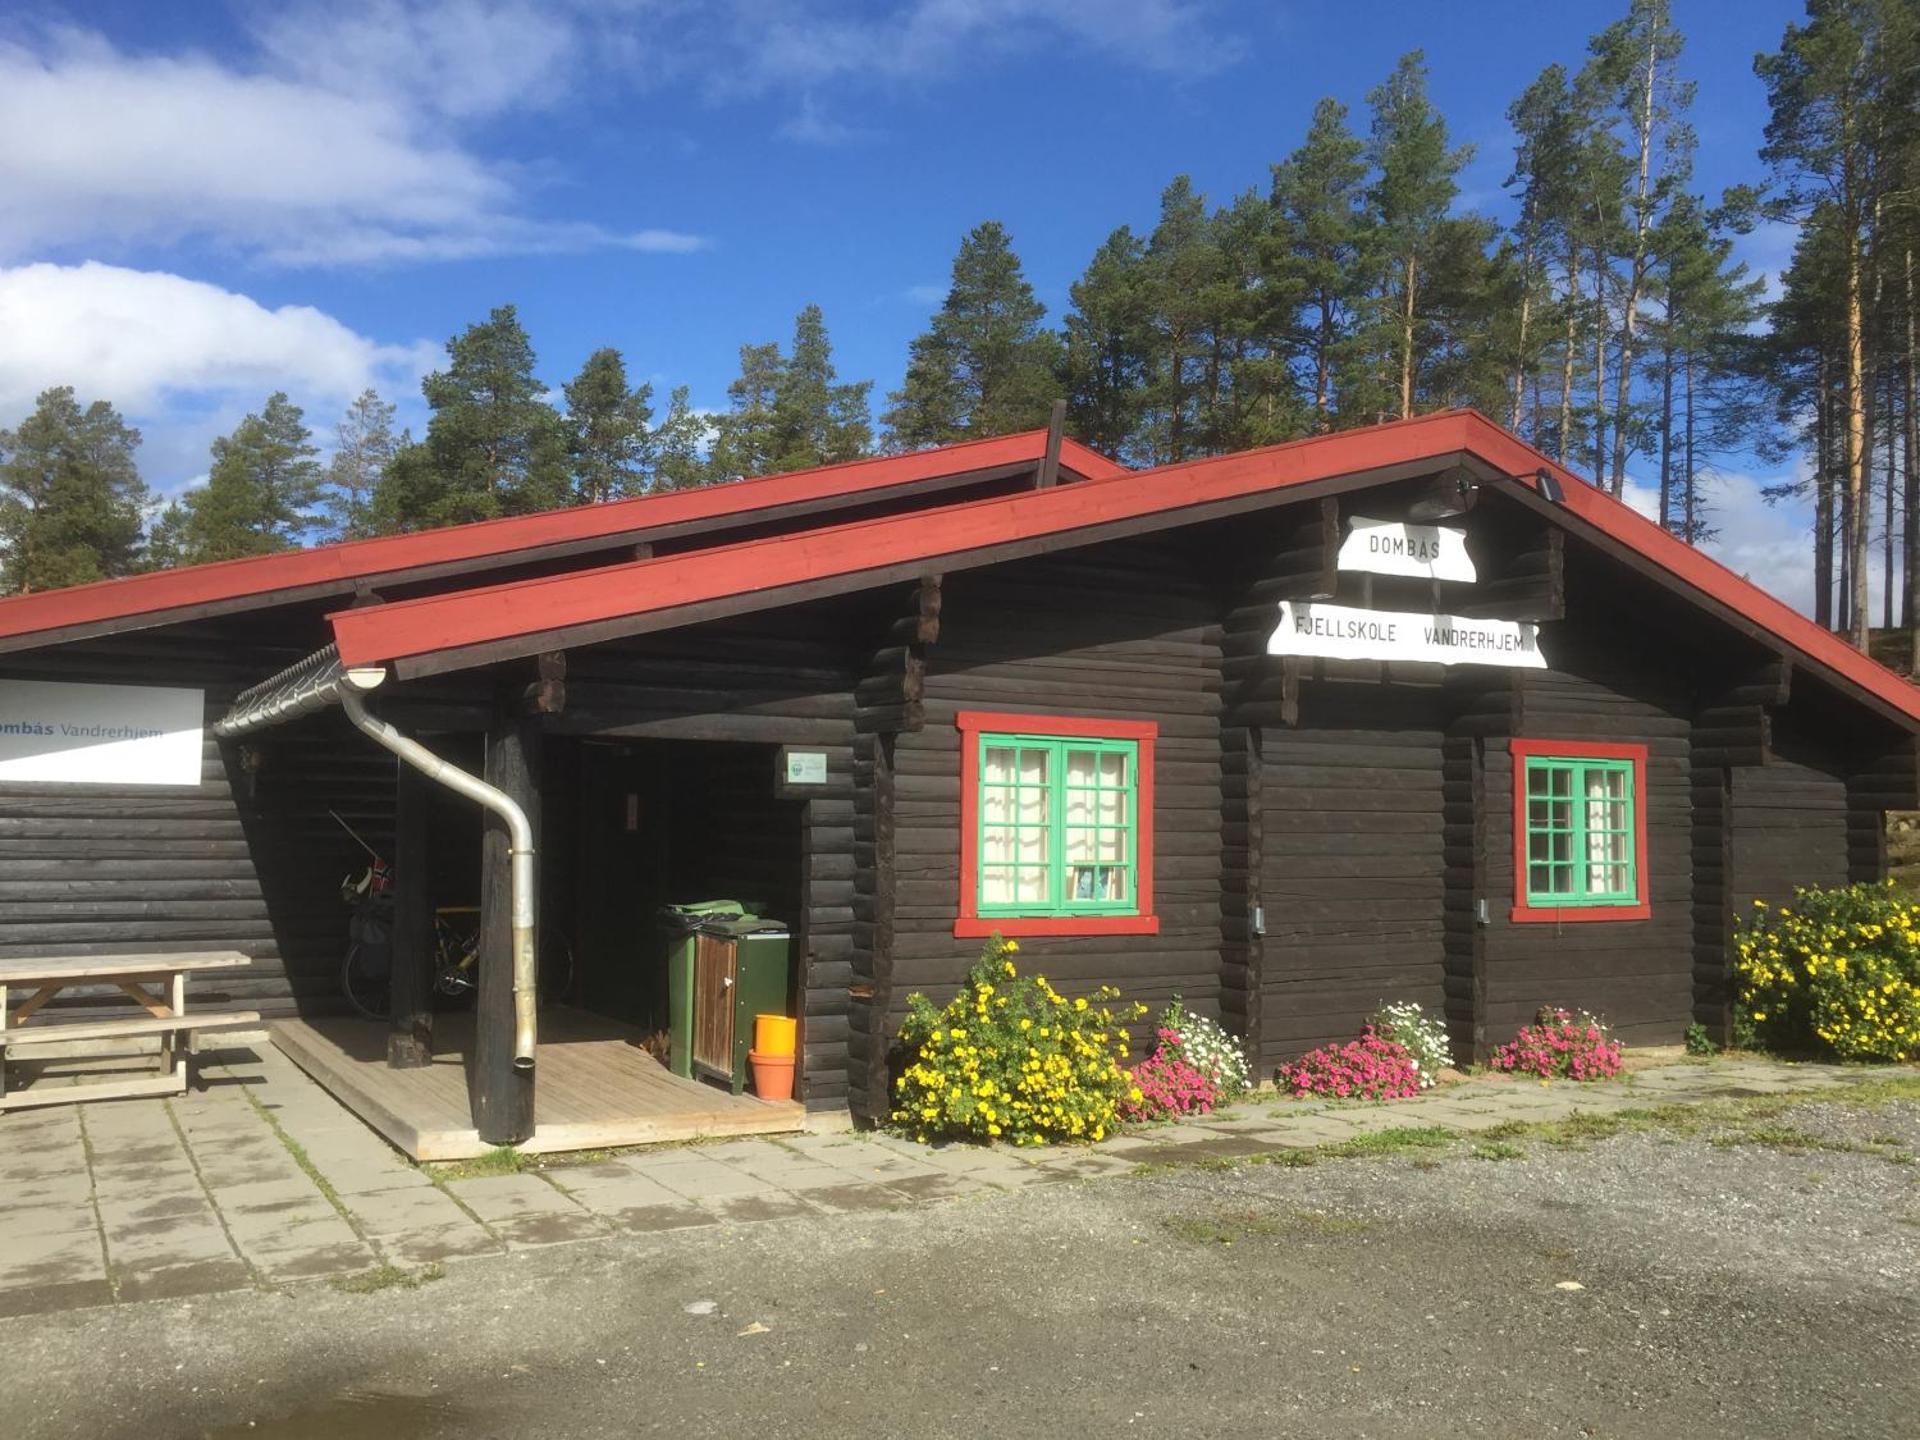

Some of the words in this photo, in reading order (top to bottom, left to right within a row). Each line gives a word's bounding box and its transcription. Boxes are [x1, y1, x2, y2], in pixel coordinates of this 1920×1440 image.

[1295, 616, 1397, 642] FJELLSKOLE
[1424, 627, 1524, 651] VANDRERHJEM
[60, 723, 164, 740] Vandrerhjem
